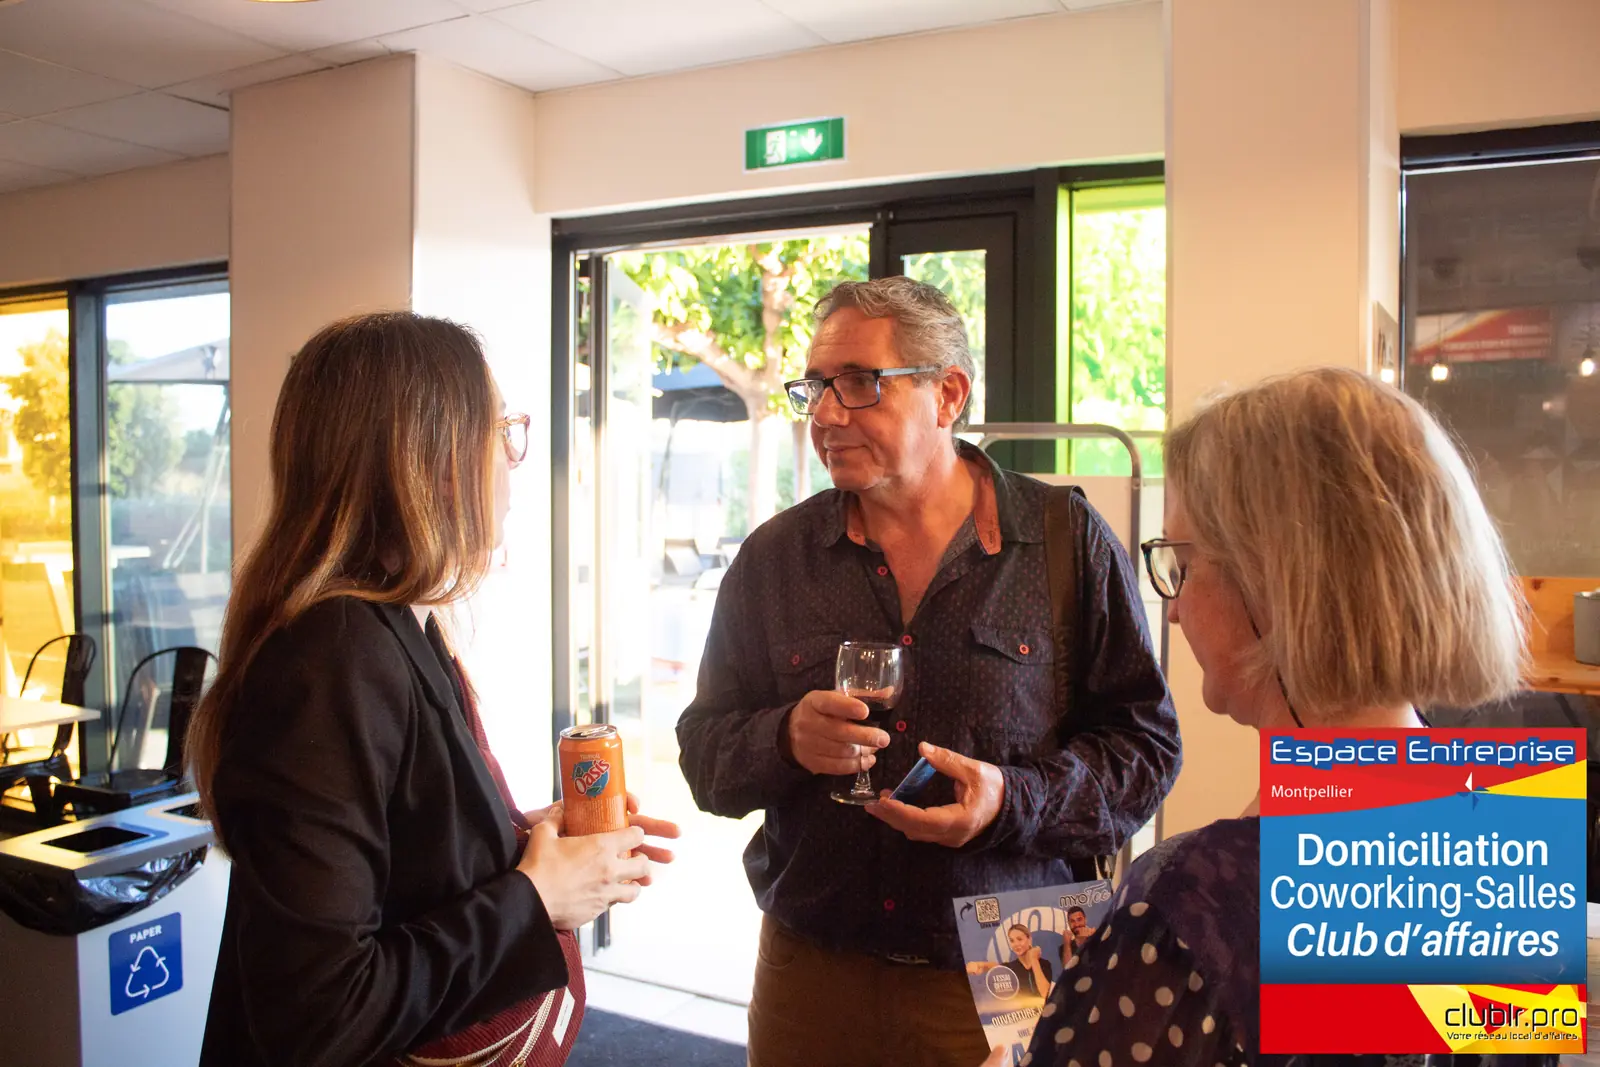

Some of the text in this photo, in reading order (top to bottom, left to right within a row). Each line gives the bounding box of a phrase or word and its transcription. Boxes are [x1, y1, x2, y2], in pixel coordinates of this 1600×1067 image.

[574, 759, 610, 796] Oasis
[129, 925, 162, 944] PAPER
[991, 1007, 1036, 1028] OUVERTURE
